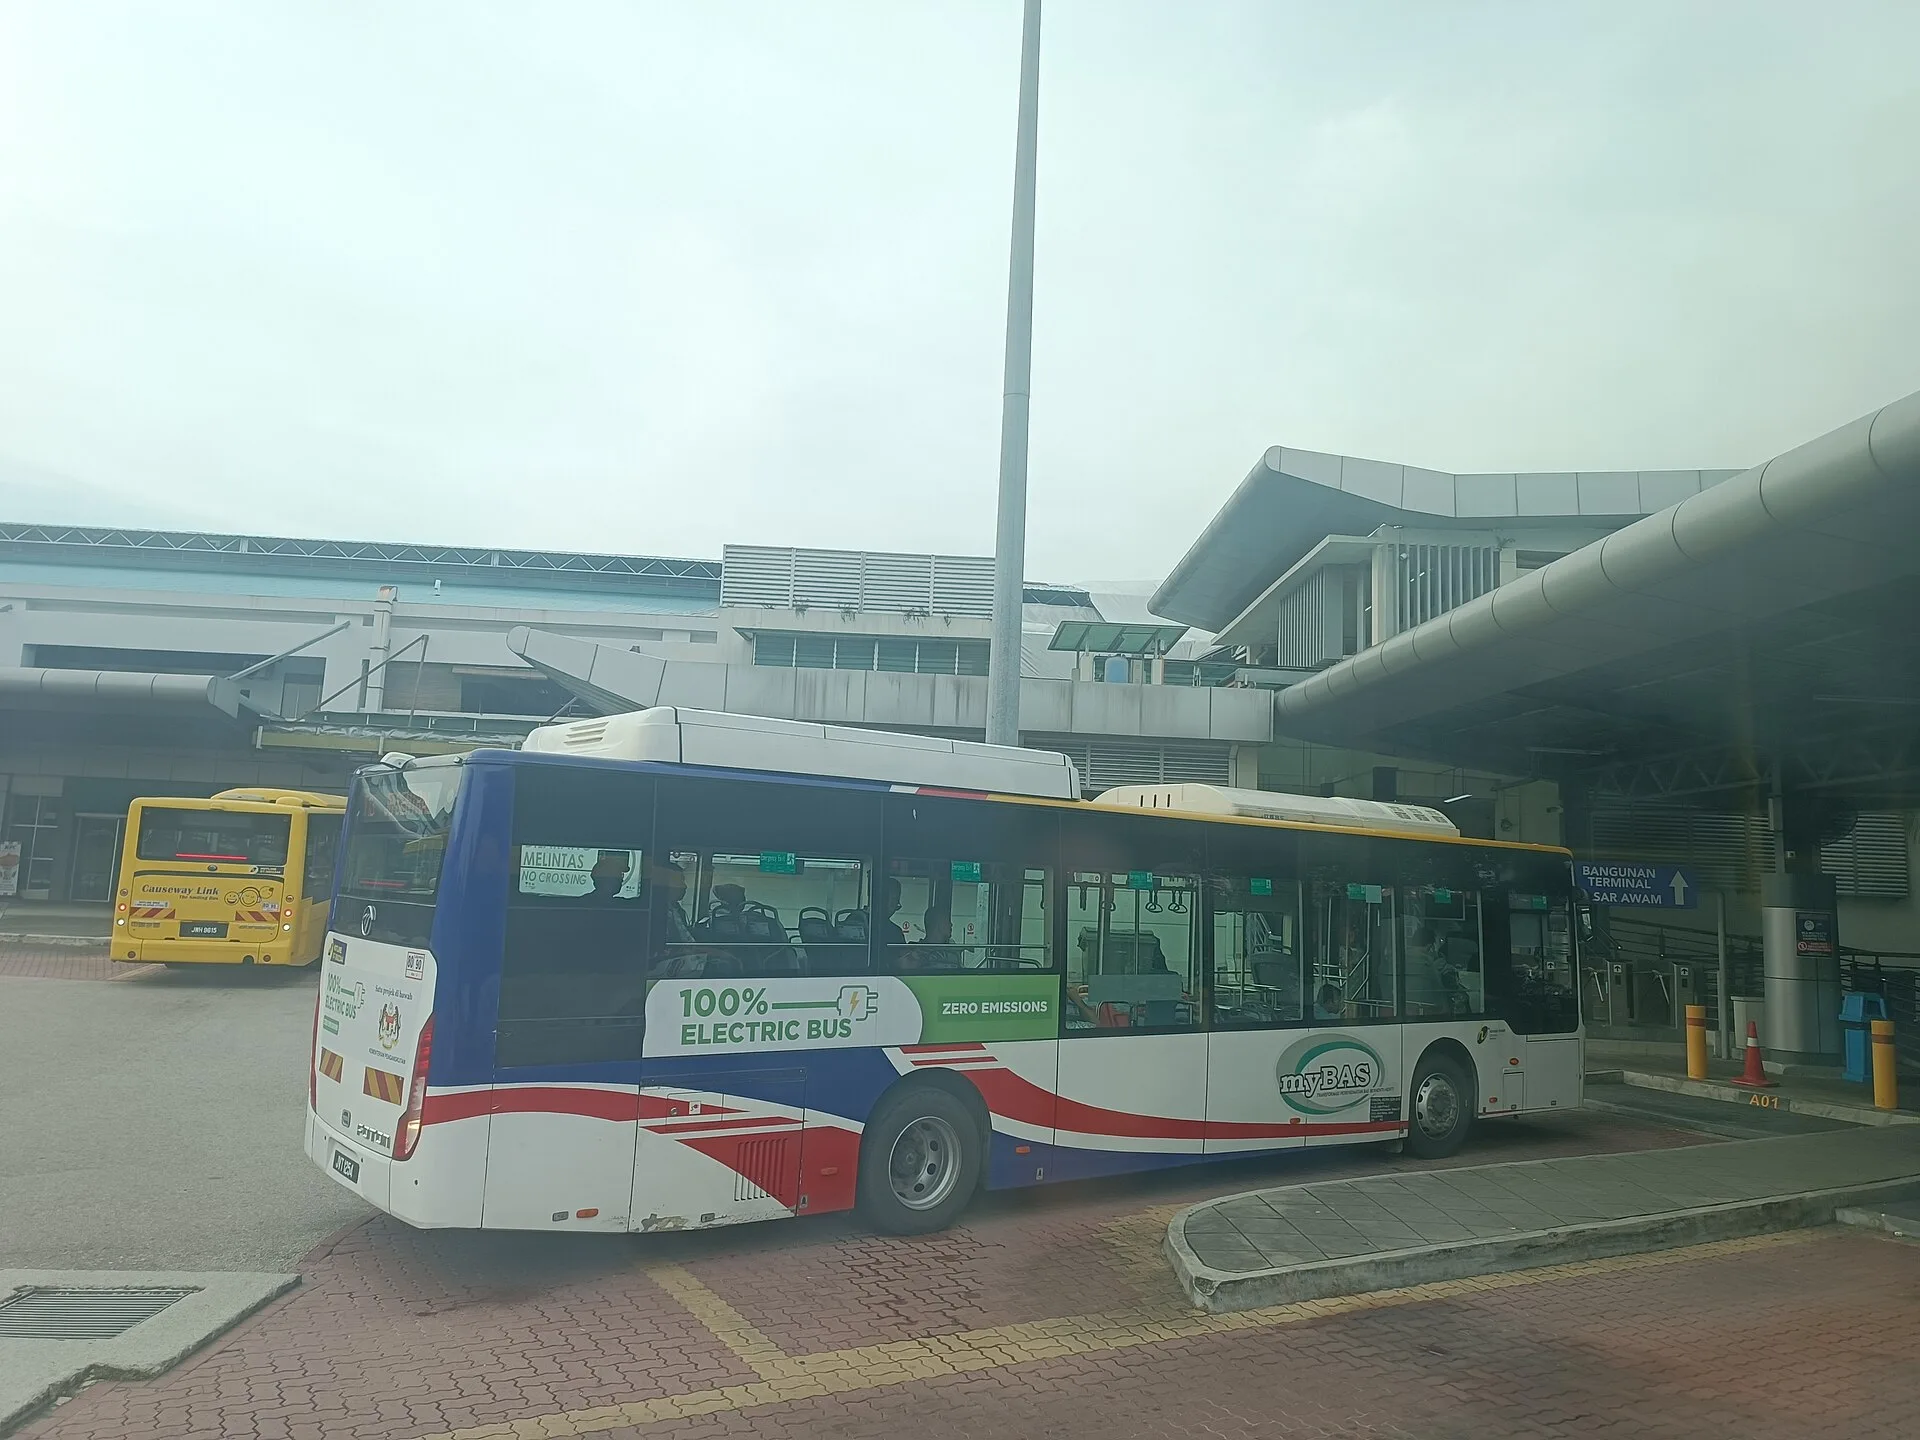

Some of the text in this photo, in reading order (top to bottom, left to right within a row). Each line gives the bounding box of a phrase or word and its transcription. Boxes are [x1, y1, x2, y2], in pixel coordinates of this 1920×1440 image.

[523, 852, 585, 868] MELINTAS
[521, 870, 587, 885] NO CROSSING
[1582, 865, 1656, 879] BANGUNAN
[141, 884, 220, 895] Causeway Link
[1587, 876, 1652, 889] TERMINAL
[1592, 891, 1662, 905] SAR AWAM
[324, 995, 357, 1020] ELECTRIC BUS
[679, 987, 768, 1017] 100%
[942, 1001, 1048, 1015] ZERO EMISSIONS
[681, 1018, 852, 1045] ELECTRIC BUS
[1280, 1063, 1371, 1098] myBAS
[1749, 1094, 1779, 1109] A01
